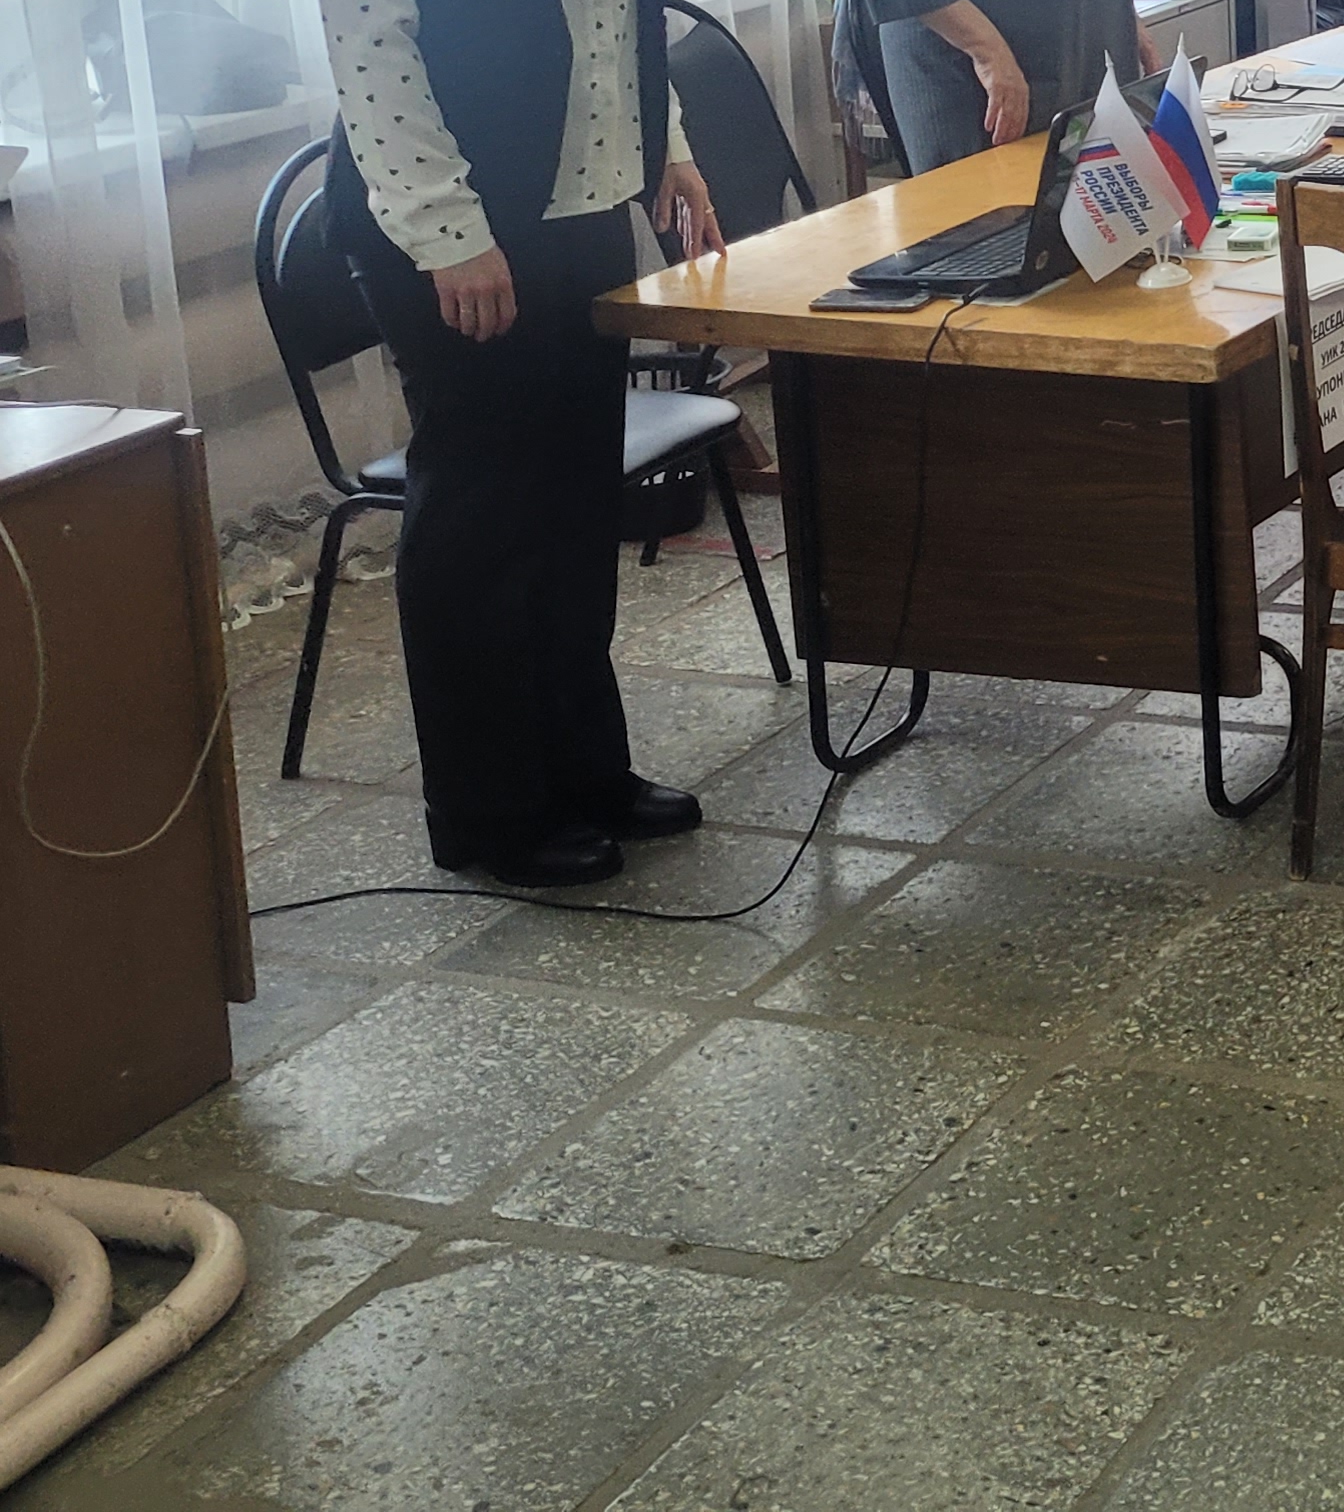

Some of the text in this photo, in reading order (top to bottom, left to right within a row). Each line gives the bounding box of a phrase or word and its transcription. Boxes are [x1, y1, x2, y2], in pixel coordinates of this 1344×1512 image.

[1080, 170, 1118, 214] РОССИИ
[1096, 166, 1149, 236] ПРЕЗИДЕНТА
[1114, 163, 1154, 211] ВЫБОРЫ
[1080, 195, 1105, 224] МАРТА
[1097, 223, 1118, 244] 2024
[1320, 345, 1339, 366] УИК
